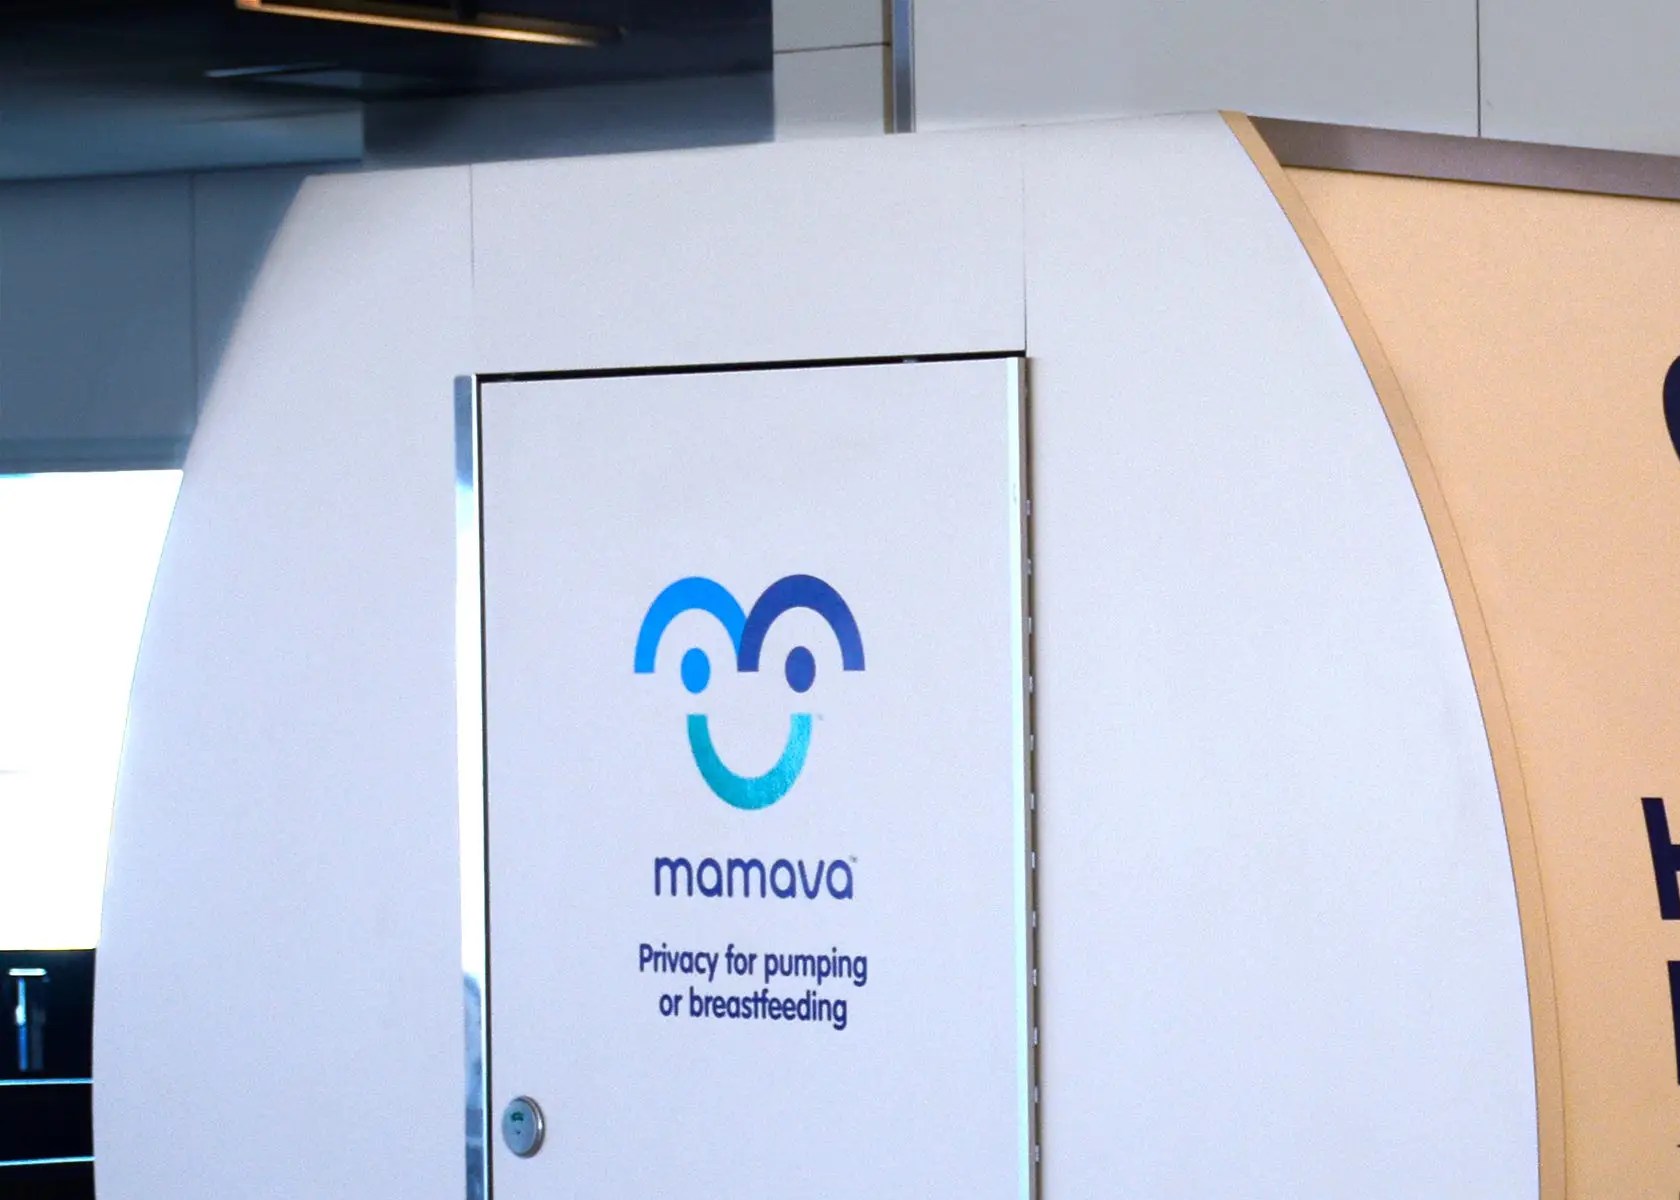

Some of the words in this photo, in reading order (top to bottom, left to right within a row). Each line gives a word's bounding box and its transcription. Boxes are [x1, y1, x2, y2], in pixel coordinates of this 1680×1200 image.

[654, 857, 855, 900] mamava
[639, 942, 719, 983] Privacy
[725, 943, 758, 976] for
[764, 946, 868, 988] pumping
[659, 993, 684, 1017] or
[689, 985, 848, 1031] breastfeeding
